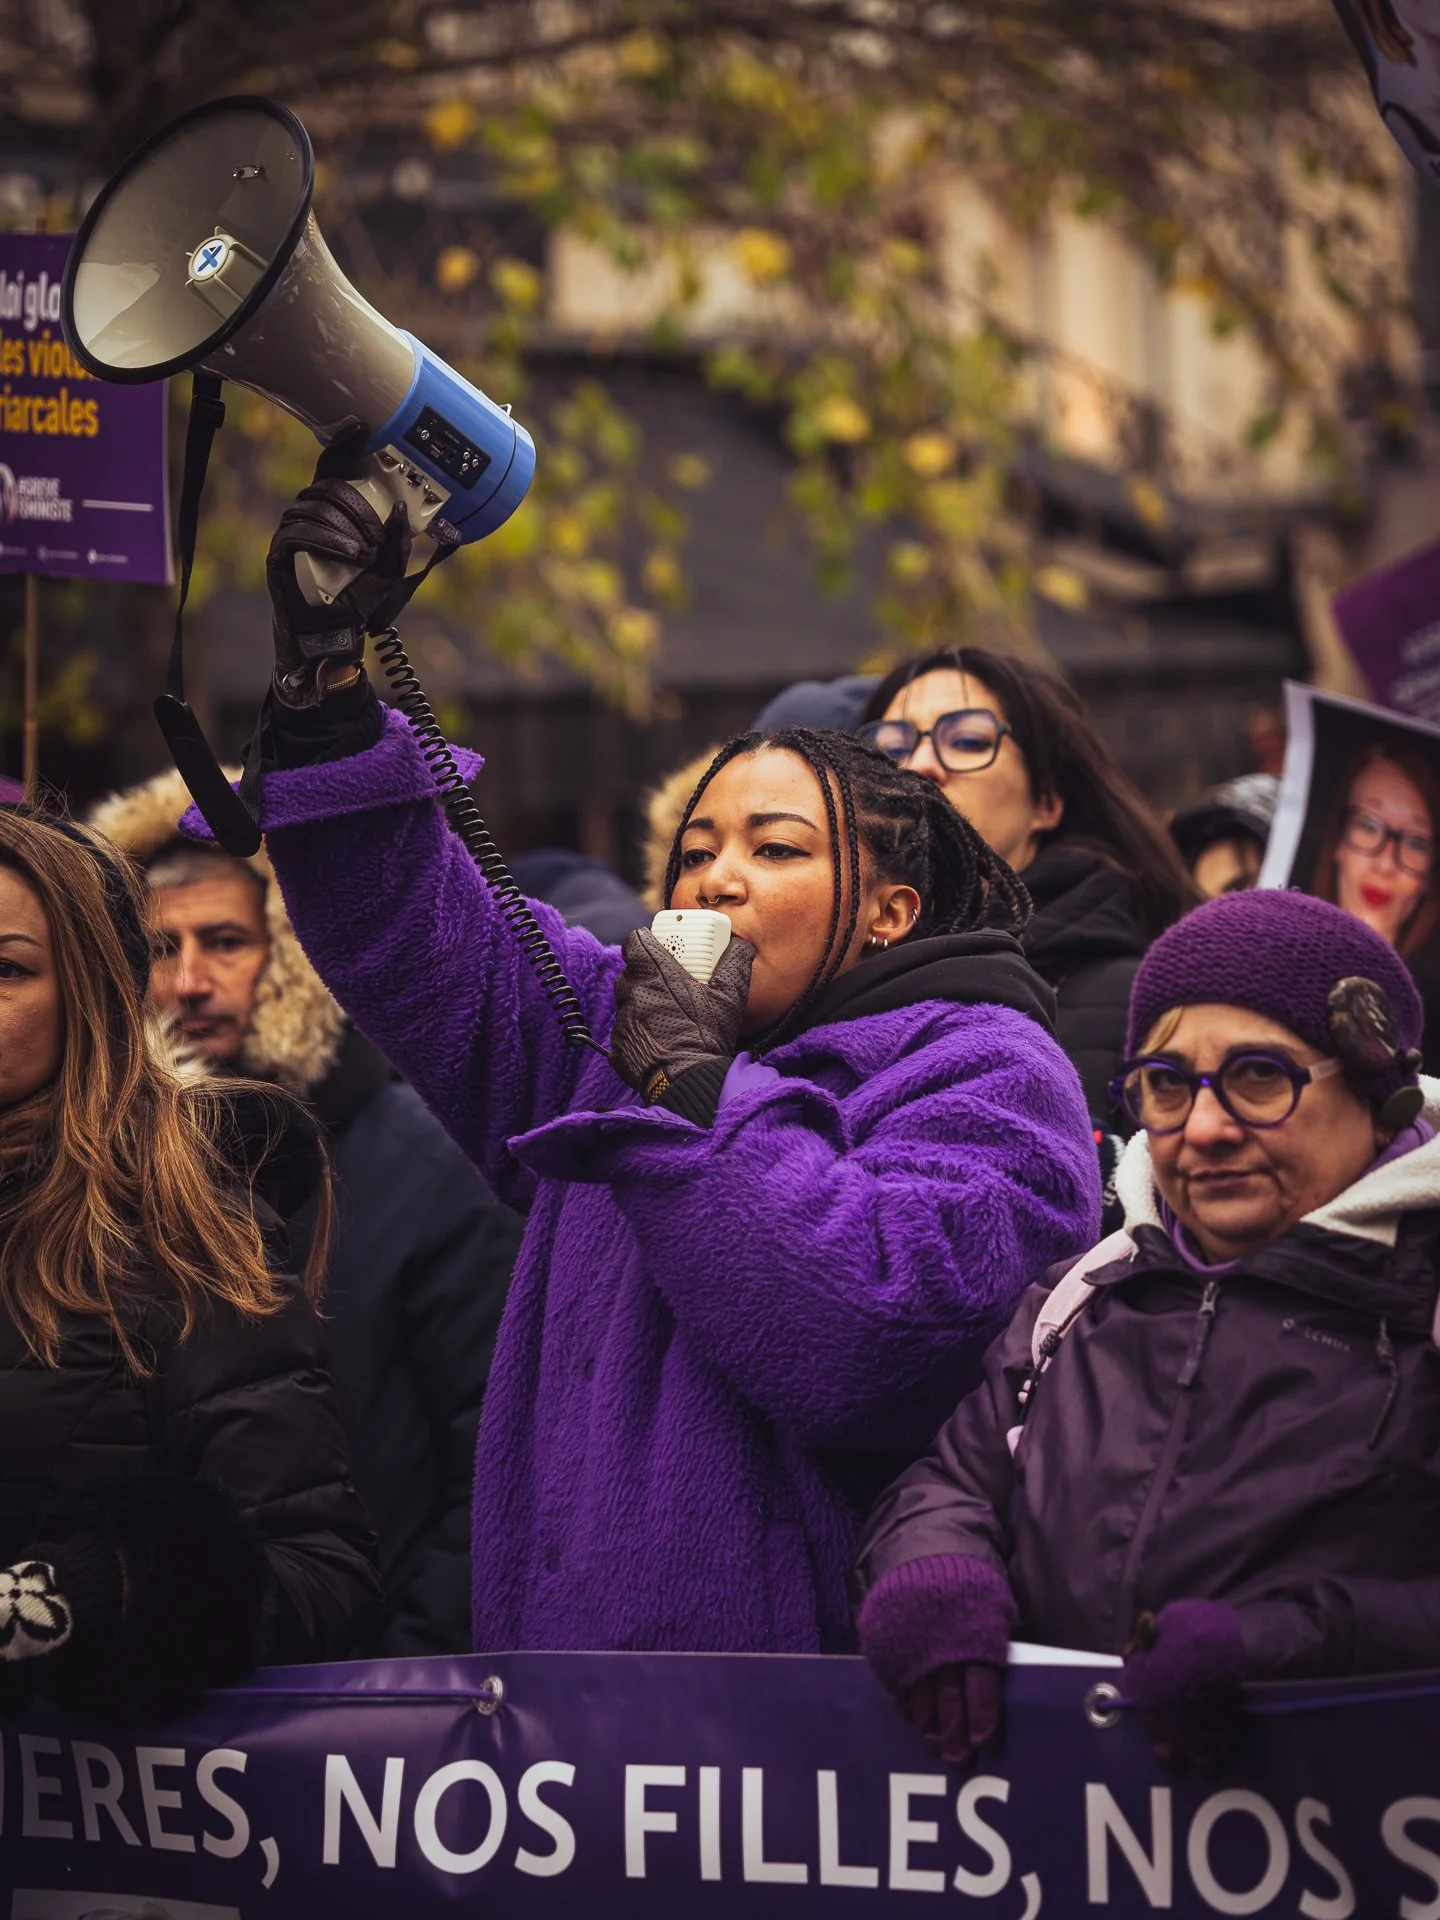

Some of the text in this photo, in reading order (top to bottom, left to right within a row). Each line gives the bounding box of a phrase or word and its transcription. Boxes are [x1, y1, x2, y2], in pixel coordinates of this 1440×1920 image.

[23, 271, 62, 331] glo
[27, 328, 95, 380] viol
[0, 1730, 280, 1889] ERES,
[323, 1754, 576, 1877] NOS
[624, 1764, 1042, 1920] FILLES,
[1085, 1783, 1355, 1920] NOS
